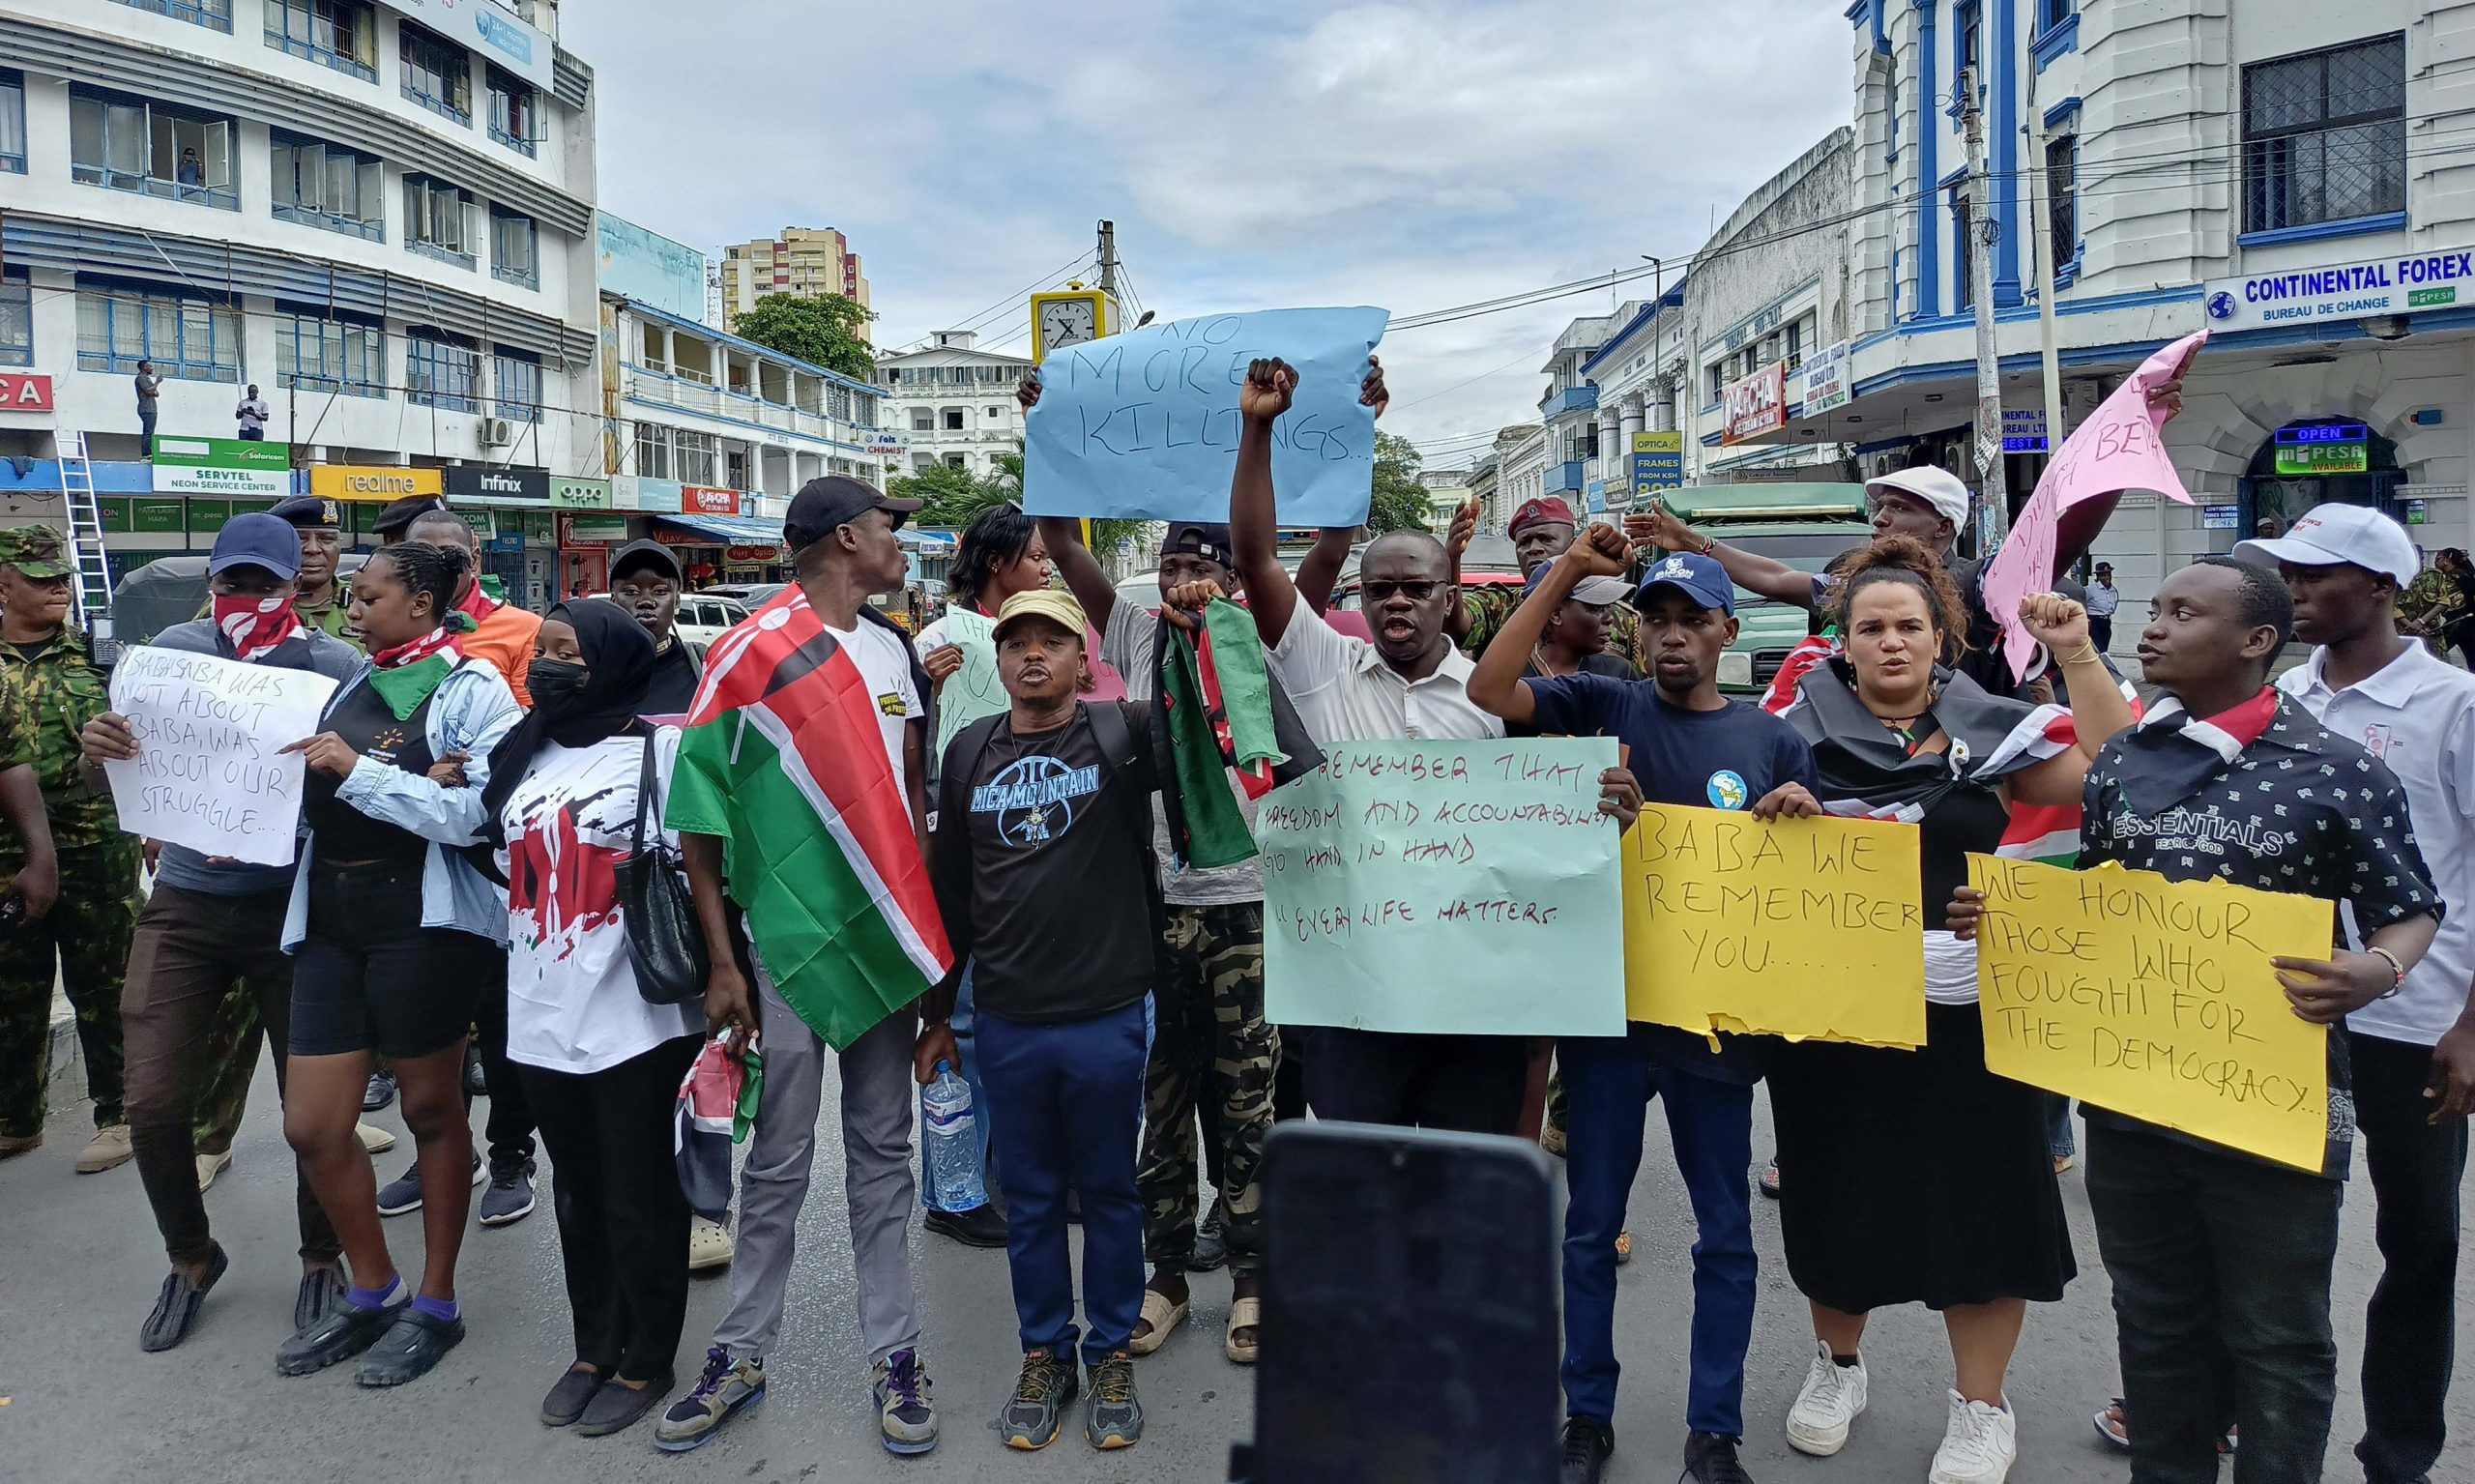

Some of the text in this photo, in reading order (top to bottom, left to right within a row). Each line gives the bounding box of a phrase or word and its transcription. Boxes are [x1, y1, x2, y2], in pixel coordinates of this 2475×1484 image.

[2245, 251, 2472, 303] CONTINENTAL FOREX
[2263, 296, 2390, 320] BUREAU DE CHANGE
[1161, 316, 1242, 345] NO
[1070, 344, 1262, 397] MORE
[2002, 411, 2036, 421] INENTAL
[2002, 424, 2028, 434] UREAU
[1637, 440, 1669, 449] OPTICA
[2298, 427, 2341, 440] OPEN
[248, 452, 285, 461] Safaricom
[867, 445, 908, 454] CHEMIST
[196, 470, 253, 481] SERVTEL
[1637, 459, 1679, 468] FRAMES
[2311, 461, 2362, 472] AVAILABLE
[171, 480, 199, 488] NEON
[201, 481, 239, 490] SERVICE
[345, 472, 416, 494] realme
[480, 474, 522, 493] Infinix
[560, 485, 604, 502] oppo
[653, 531, 681, 543] VIJAY
[732, 547, 748, 558] Vijay
[228, 672, 285, 697] WAS
[117, 684, 273, 731] NOT ABOUT
[209, 727, 260, 761] WAS
[139, 749, 287, 799] ABOUT OUR
[1318, 748, 1585, 793] REMEMBER THAT
[1008, 764, 1100, 809] MOUNTAIN
[1265, 801, 1343, 831] FREEDOM
[1364, 798, 1420, 828] AND
[1637, 808, 1879, 875] BABA WE
[2112, 810, 2284, 858] ESSENTIALS
[2155, 838, 2181, 850] FEAR
[2198, 840, 2224, 855] GOD
[1262, 832, 1475, 879] GO HAND IN HAND
[1361, 899, 1415, 928] LIFE
[1645, 873, 1922, 932] REMEMBER
[1977, 858, 2268, 954] WE HONOUR
[1978, 910, 2226, 995] THOSE WHO
[1990, 961, 2266, 1044] FOUGHT FOR
[1995, 1005, 2067, 1051] THE
